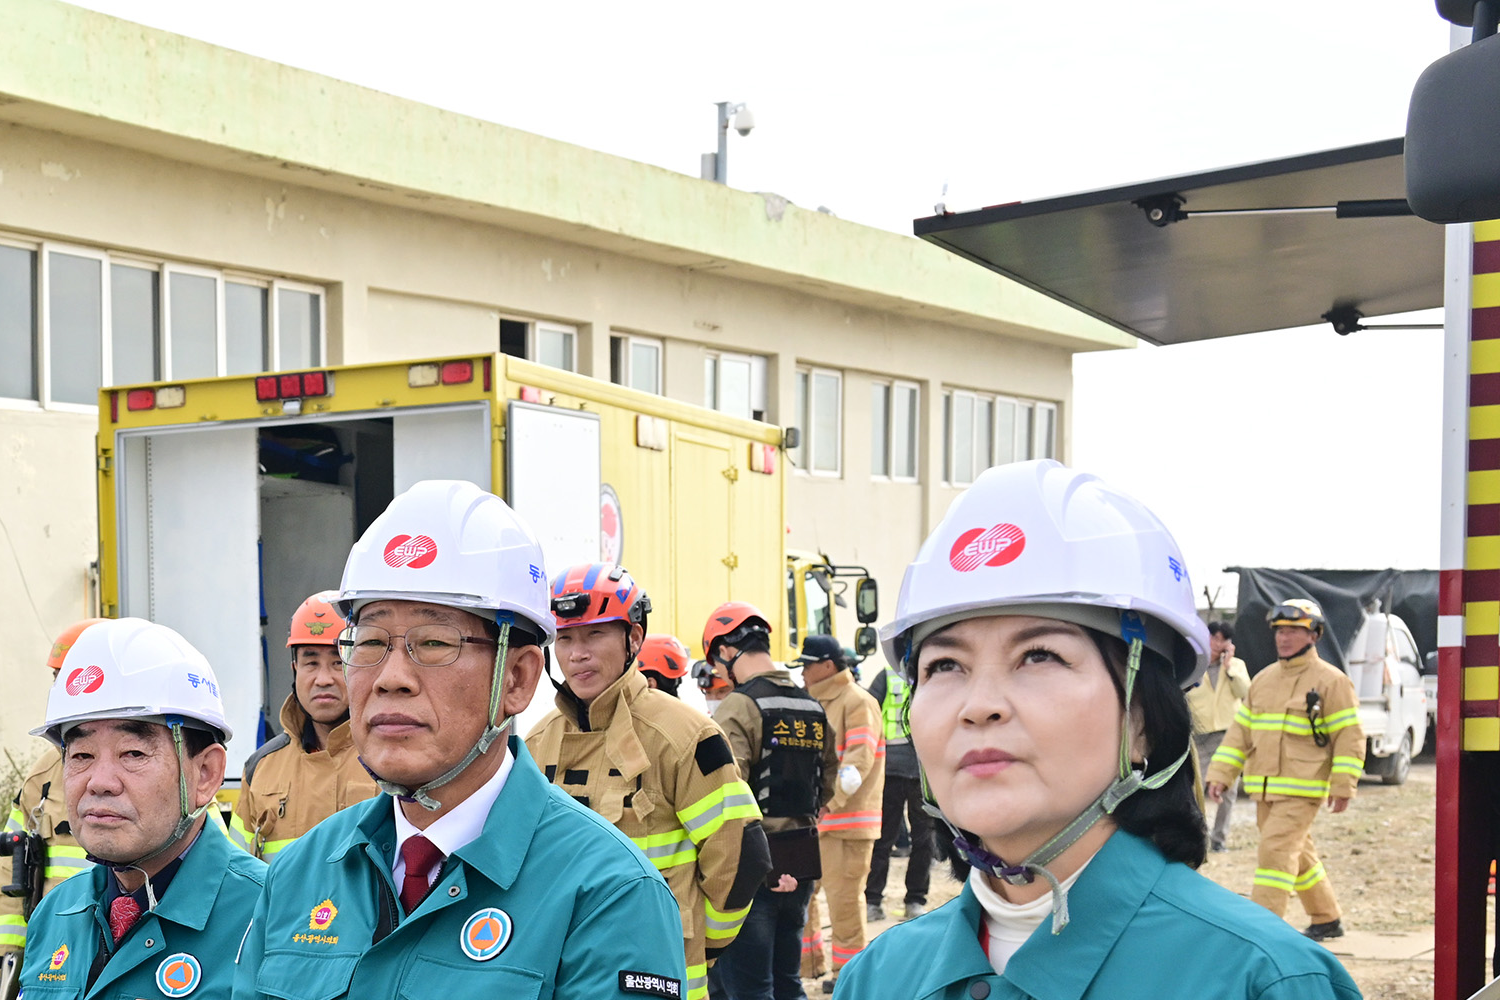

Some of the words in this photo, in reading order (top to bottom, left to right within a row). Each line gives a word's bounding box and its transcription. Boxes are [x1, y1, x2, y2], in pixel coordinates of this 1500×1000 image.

[393, 546, 428, 557] EWP
[963, 537, 1012, 556] EWP
[72, 674, 97, 686] EWP
[773, 720, 824, 740] 소방청
[625, 974, 666, 993] 울산광역시
[666, 981, 679, 996] 의회
